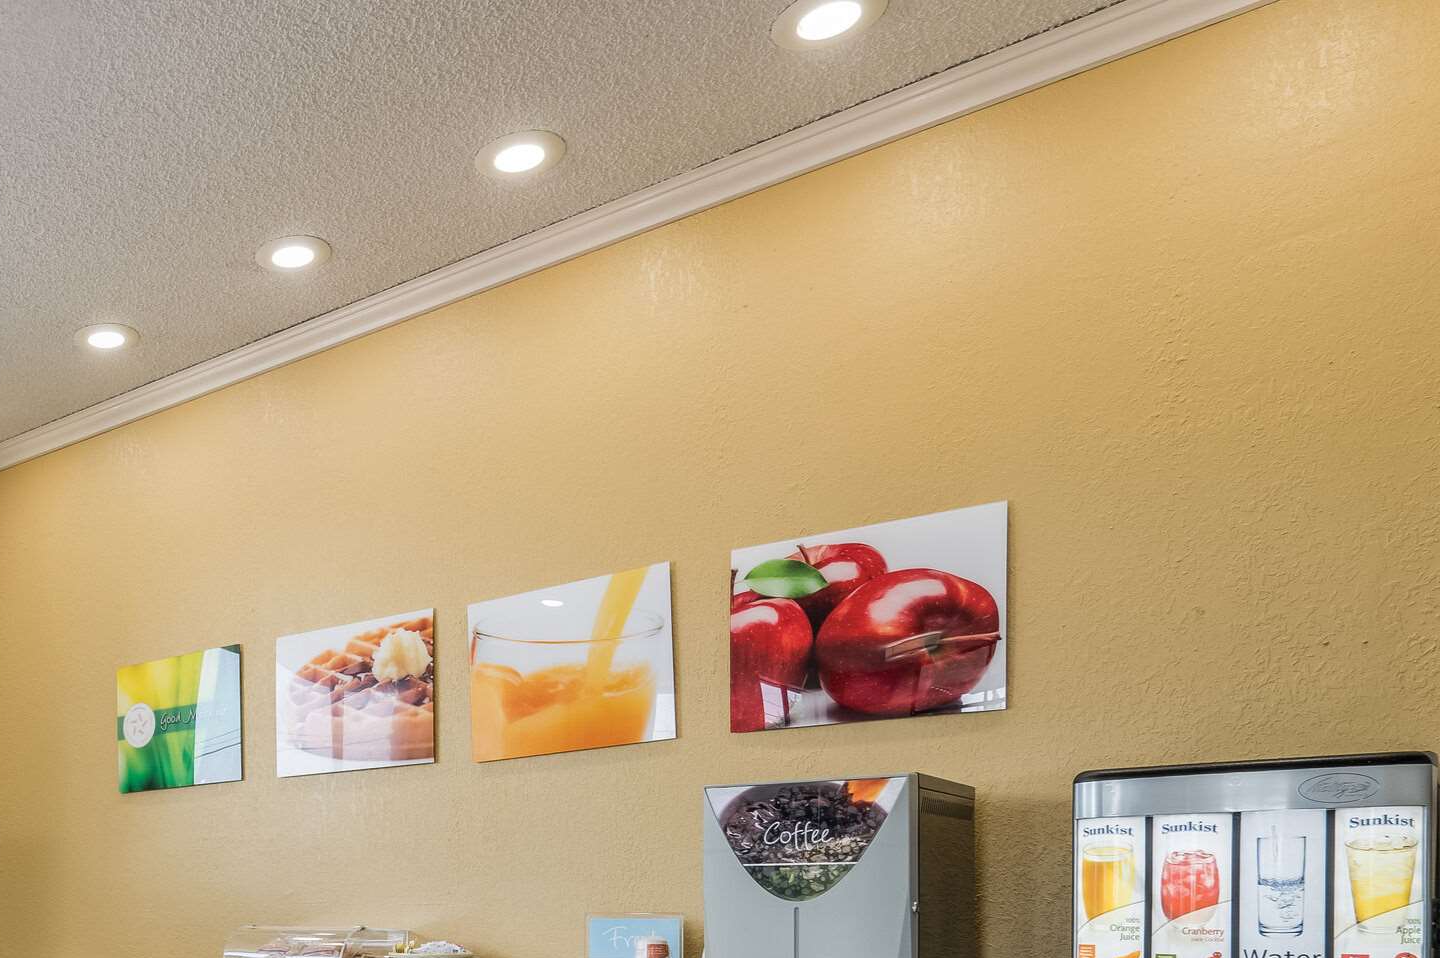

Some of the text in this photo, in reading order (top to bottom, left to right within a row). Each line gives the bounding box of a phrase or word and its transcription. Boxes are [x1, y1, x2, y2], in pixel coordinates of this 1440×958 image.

[160, 711, 181, 731] Good
[1349, 814, 1415, 828] Sunkist
[1083, 824, 1134, 837] Sunkist
[1161, 821, 1218, 834] Sunkist
[764, 821, 835, 851] Coffee
[1110, 923, 1140, 933] Orange
[1182, 926, 1224, 938] Cranberry
[1395, 925, 1421, 937] Apple
[1120, 933, 1140, 941] Juice
[1400, 935, 1421, 945] Juice
